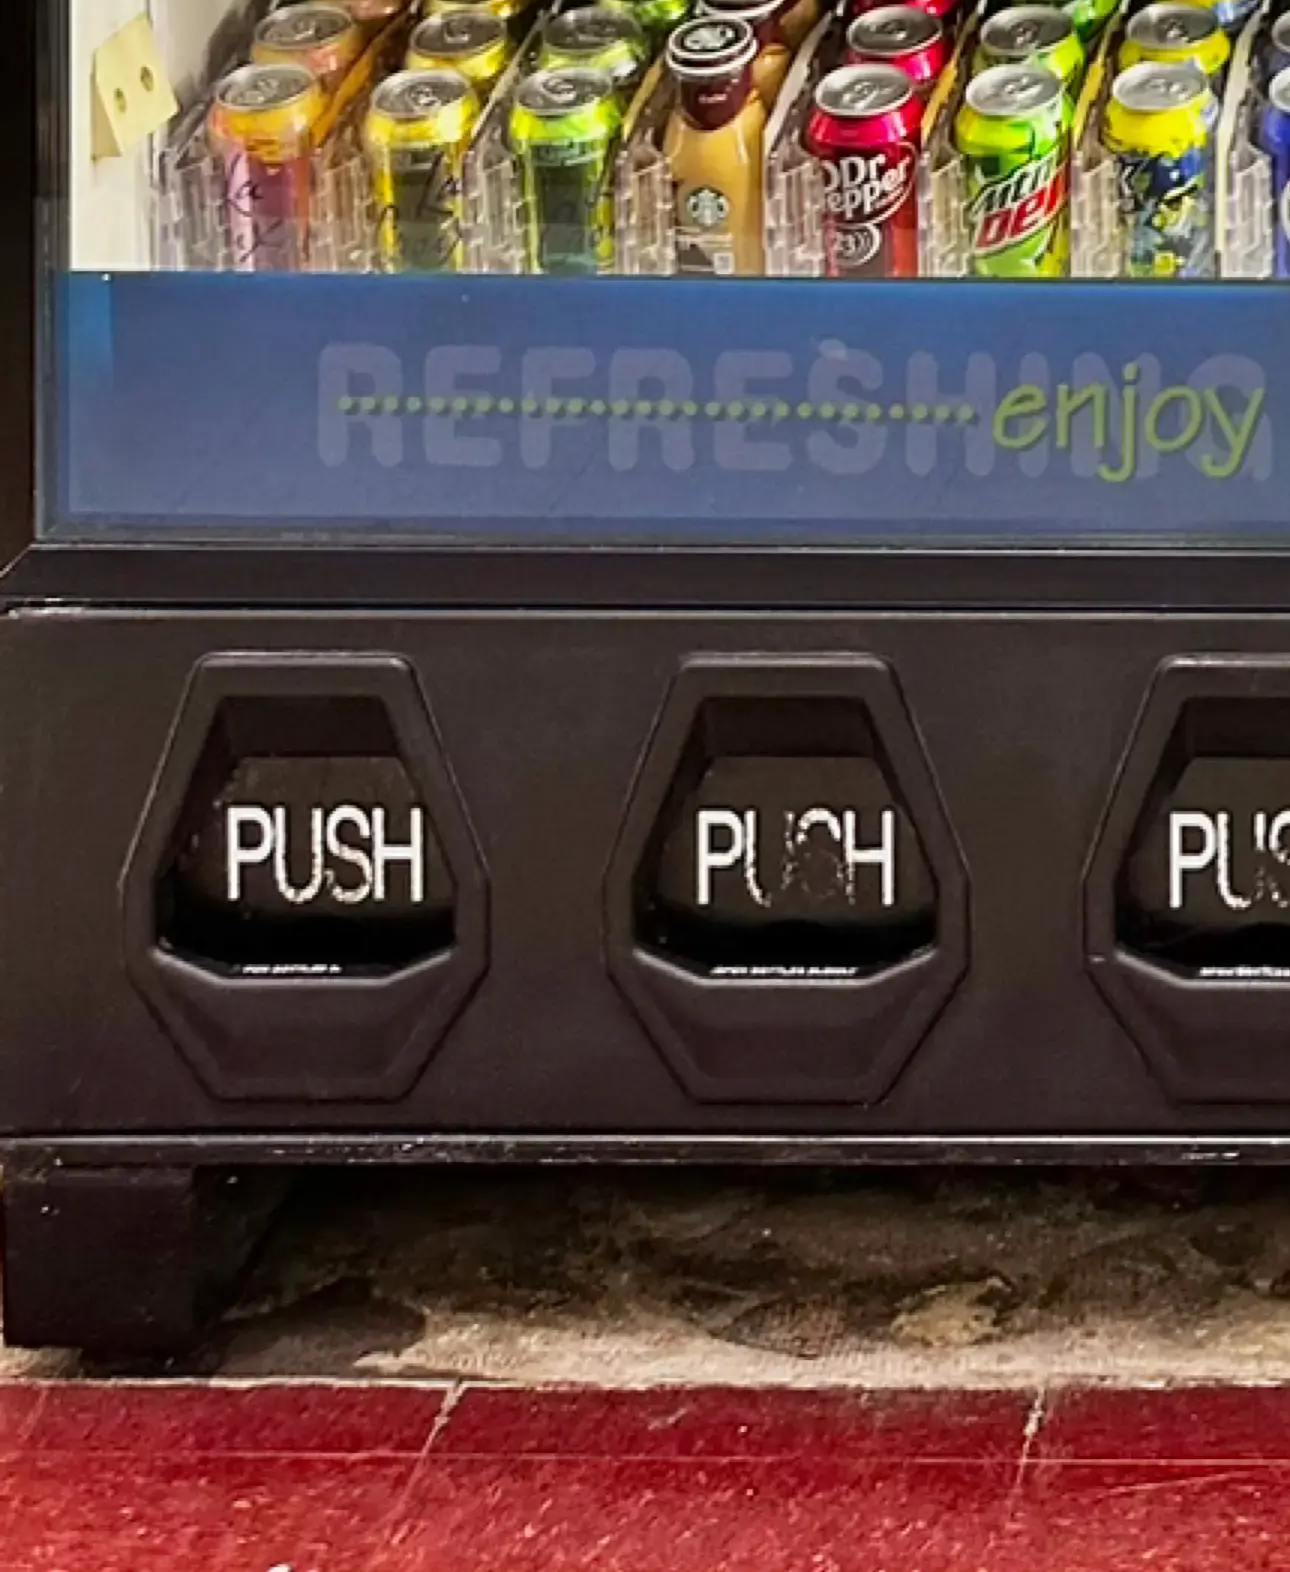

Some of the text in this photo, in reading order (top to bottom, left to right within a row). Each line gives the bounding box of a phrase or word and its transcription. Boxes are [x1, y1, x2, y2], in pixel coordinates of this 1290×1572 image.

[824, 155, 912, 220] epper
[989, 364, 1264, 484] enjoy
[226, 806, 425, 904] PUSH
